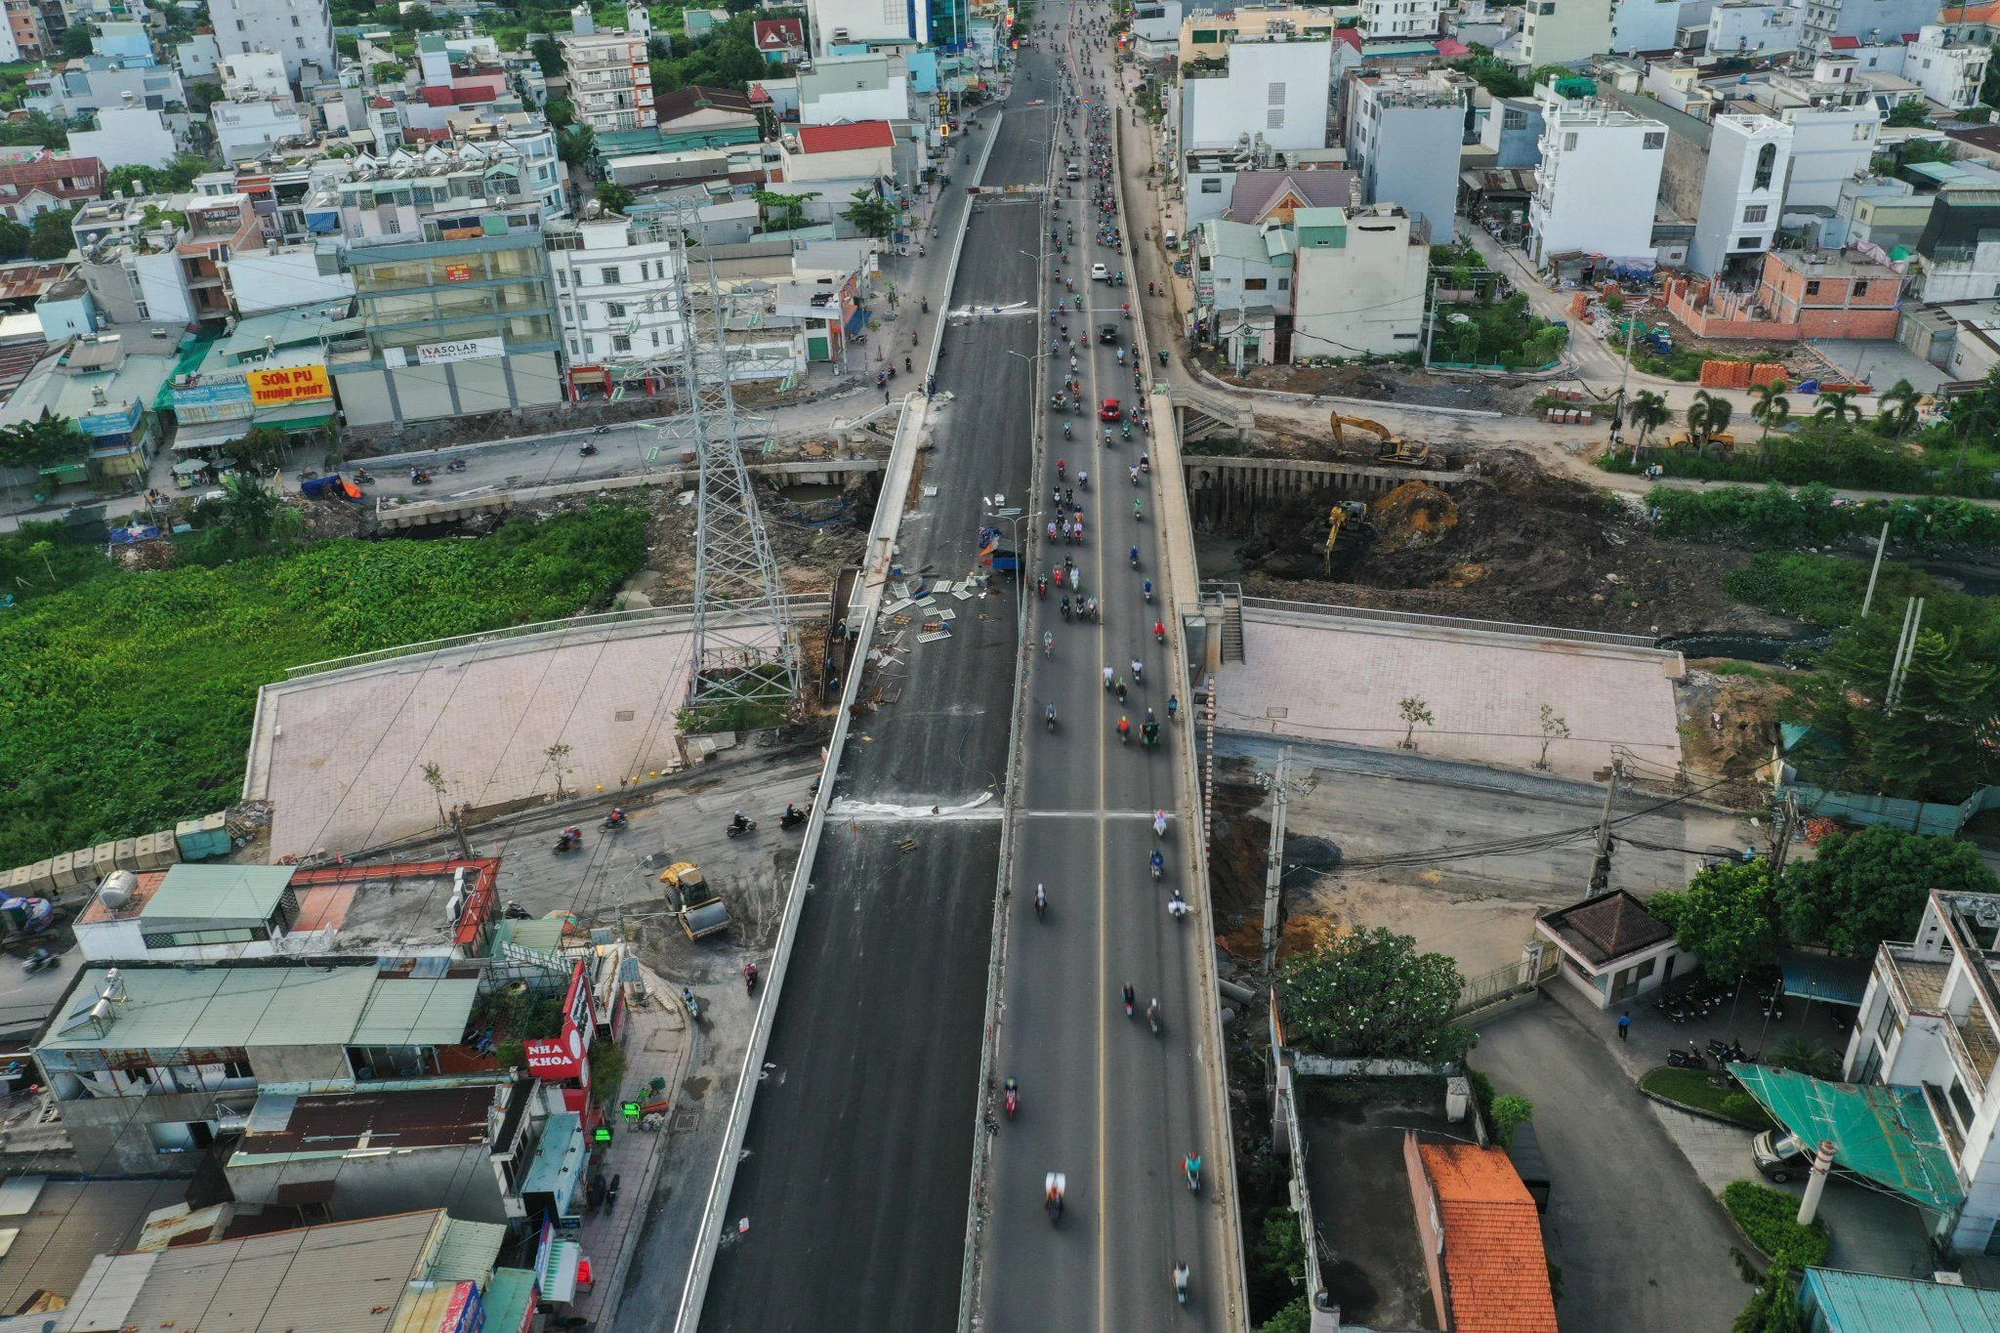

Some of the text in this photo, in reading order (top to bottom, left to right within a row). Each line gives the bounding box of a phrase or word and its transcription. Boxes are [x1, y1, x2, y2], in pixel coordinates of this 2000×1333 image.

[261, 370, 312, 387] SƠN PU
[295, 382, 324, 397] PHÁT
[528, 1045, 563, 1055] NHA
[528, 1056, 572, 1067] KHOA
